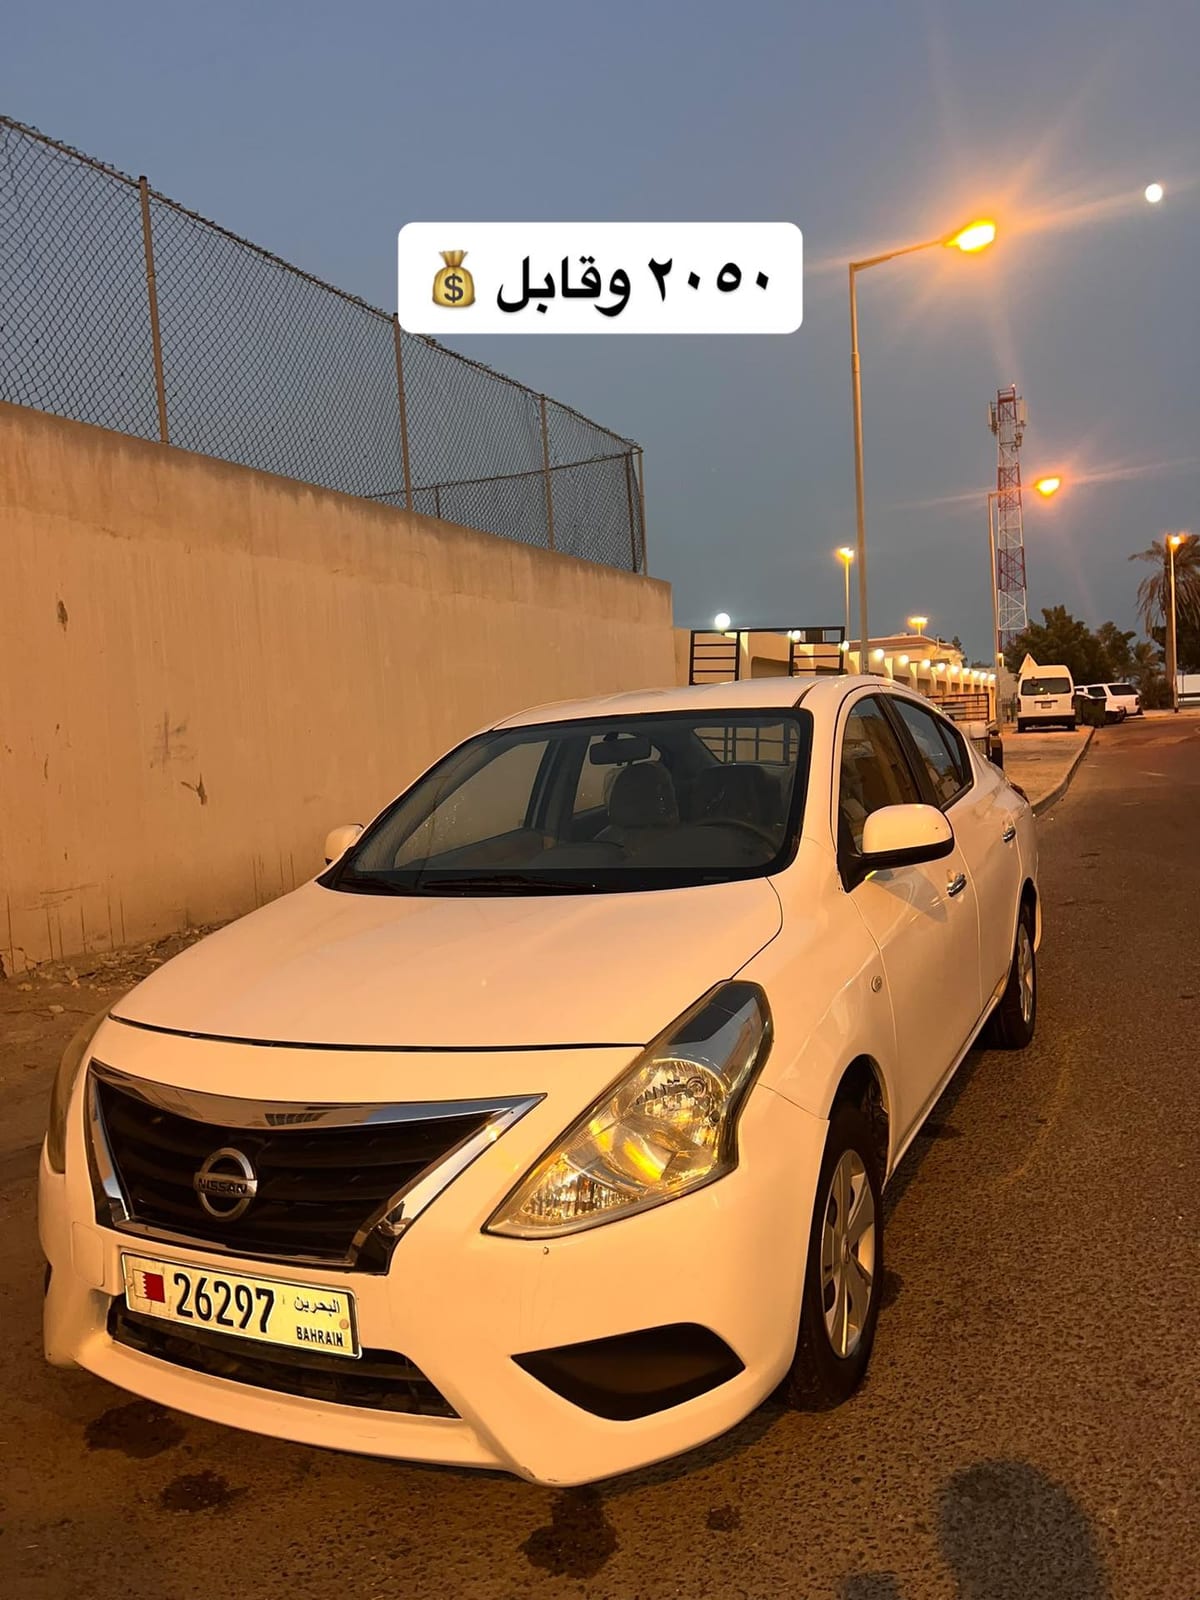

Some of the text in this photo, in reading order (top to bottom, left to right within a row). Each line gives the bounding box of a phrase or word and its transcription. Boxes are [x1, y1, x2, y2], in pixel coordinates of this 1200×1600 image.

[198, 1178, 247, 1194] NISSAN
[173, 1272, 275, 1333] 26297
[294, 1296, 340, 1318] البحرين
[296, 1326, 344, 1347] BAHRAIN
